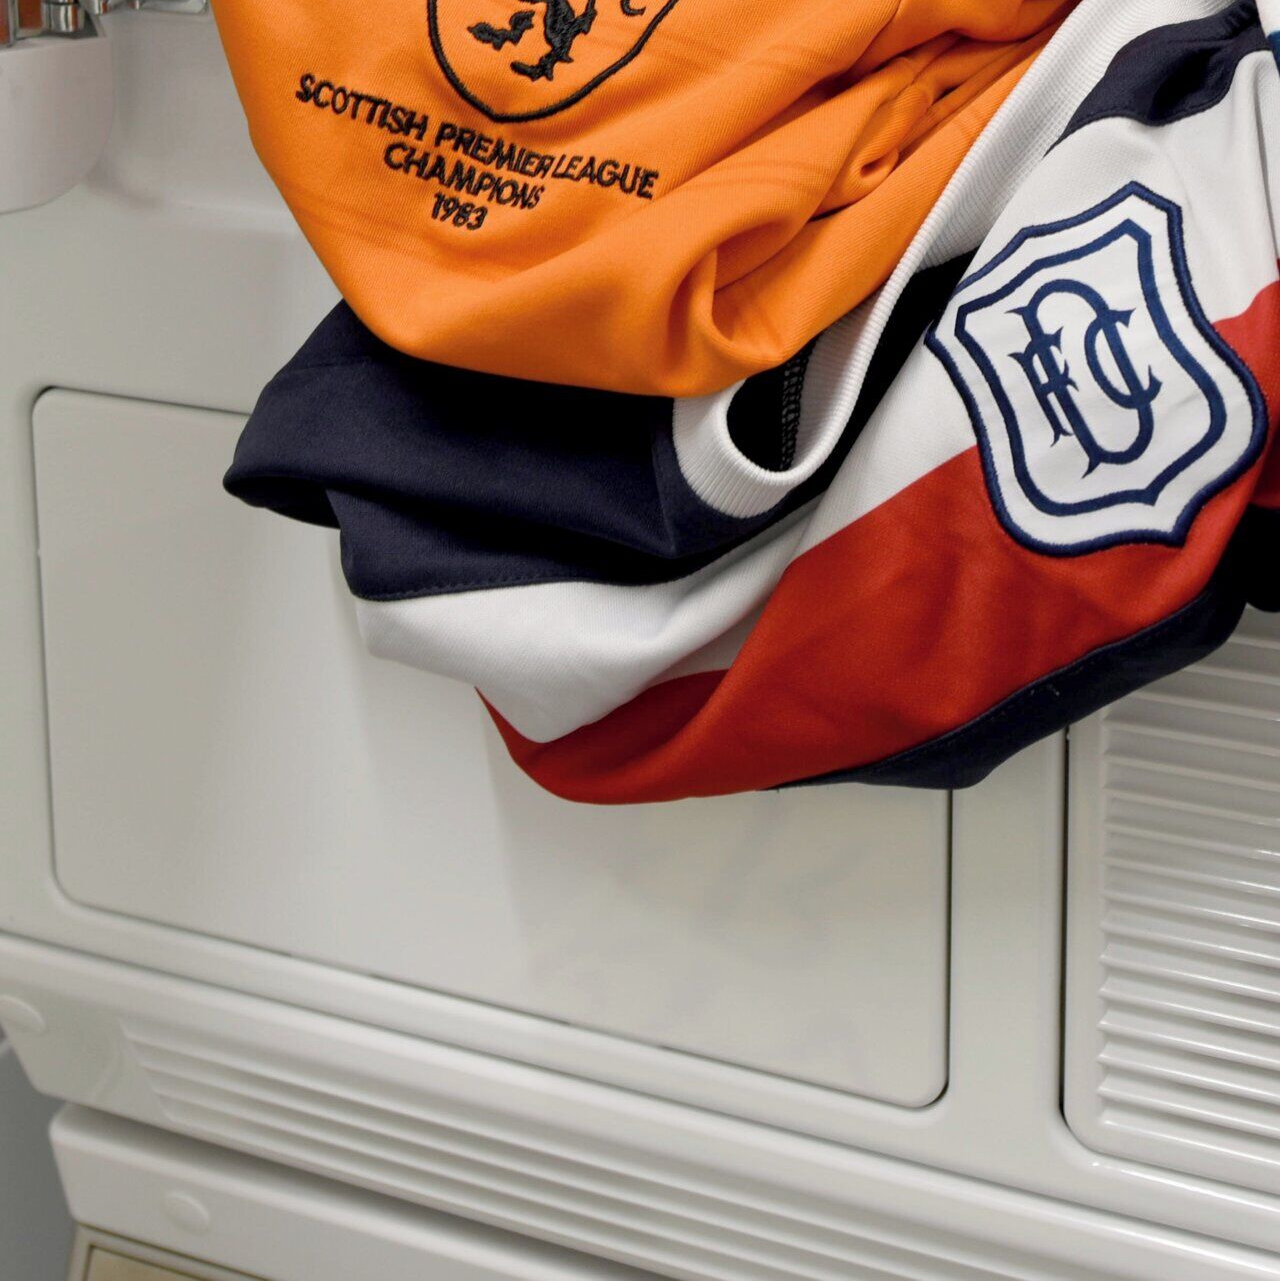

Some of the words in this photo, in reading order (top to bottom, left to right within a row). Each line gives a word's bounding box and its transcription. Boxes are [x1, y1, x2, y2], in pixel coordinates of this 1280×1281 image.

[294, 71, 430, 142] SCOTTISH
[434, 121, 556, 180] PREMIER
[551, 153, 660, 200] LEAGUE
[383, 141, 546, 210] CHAMPIONS
[430, 192, 489, 232] 1983
